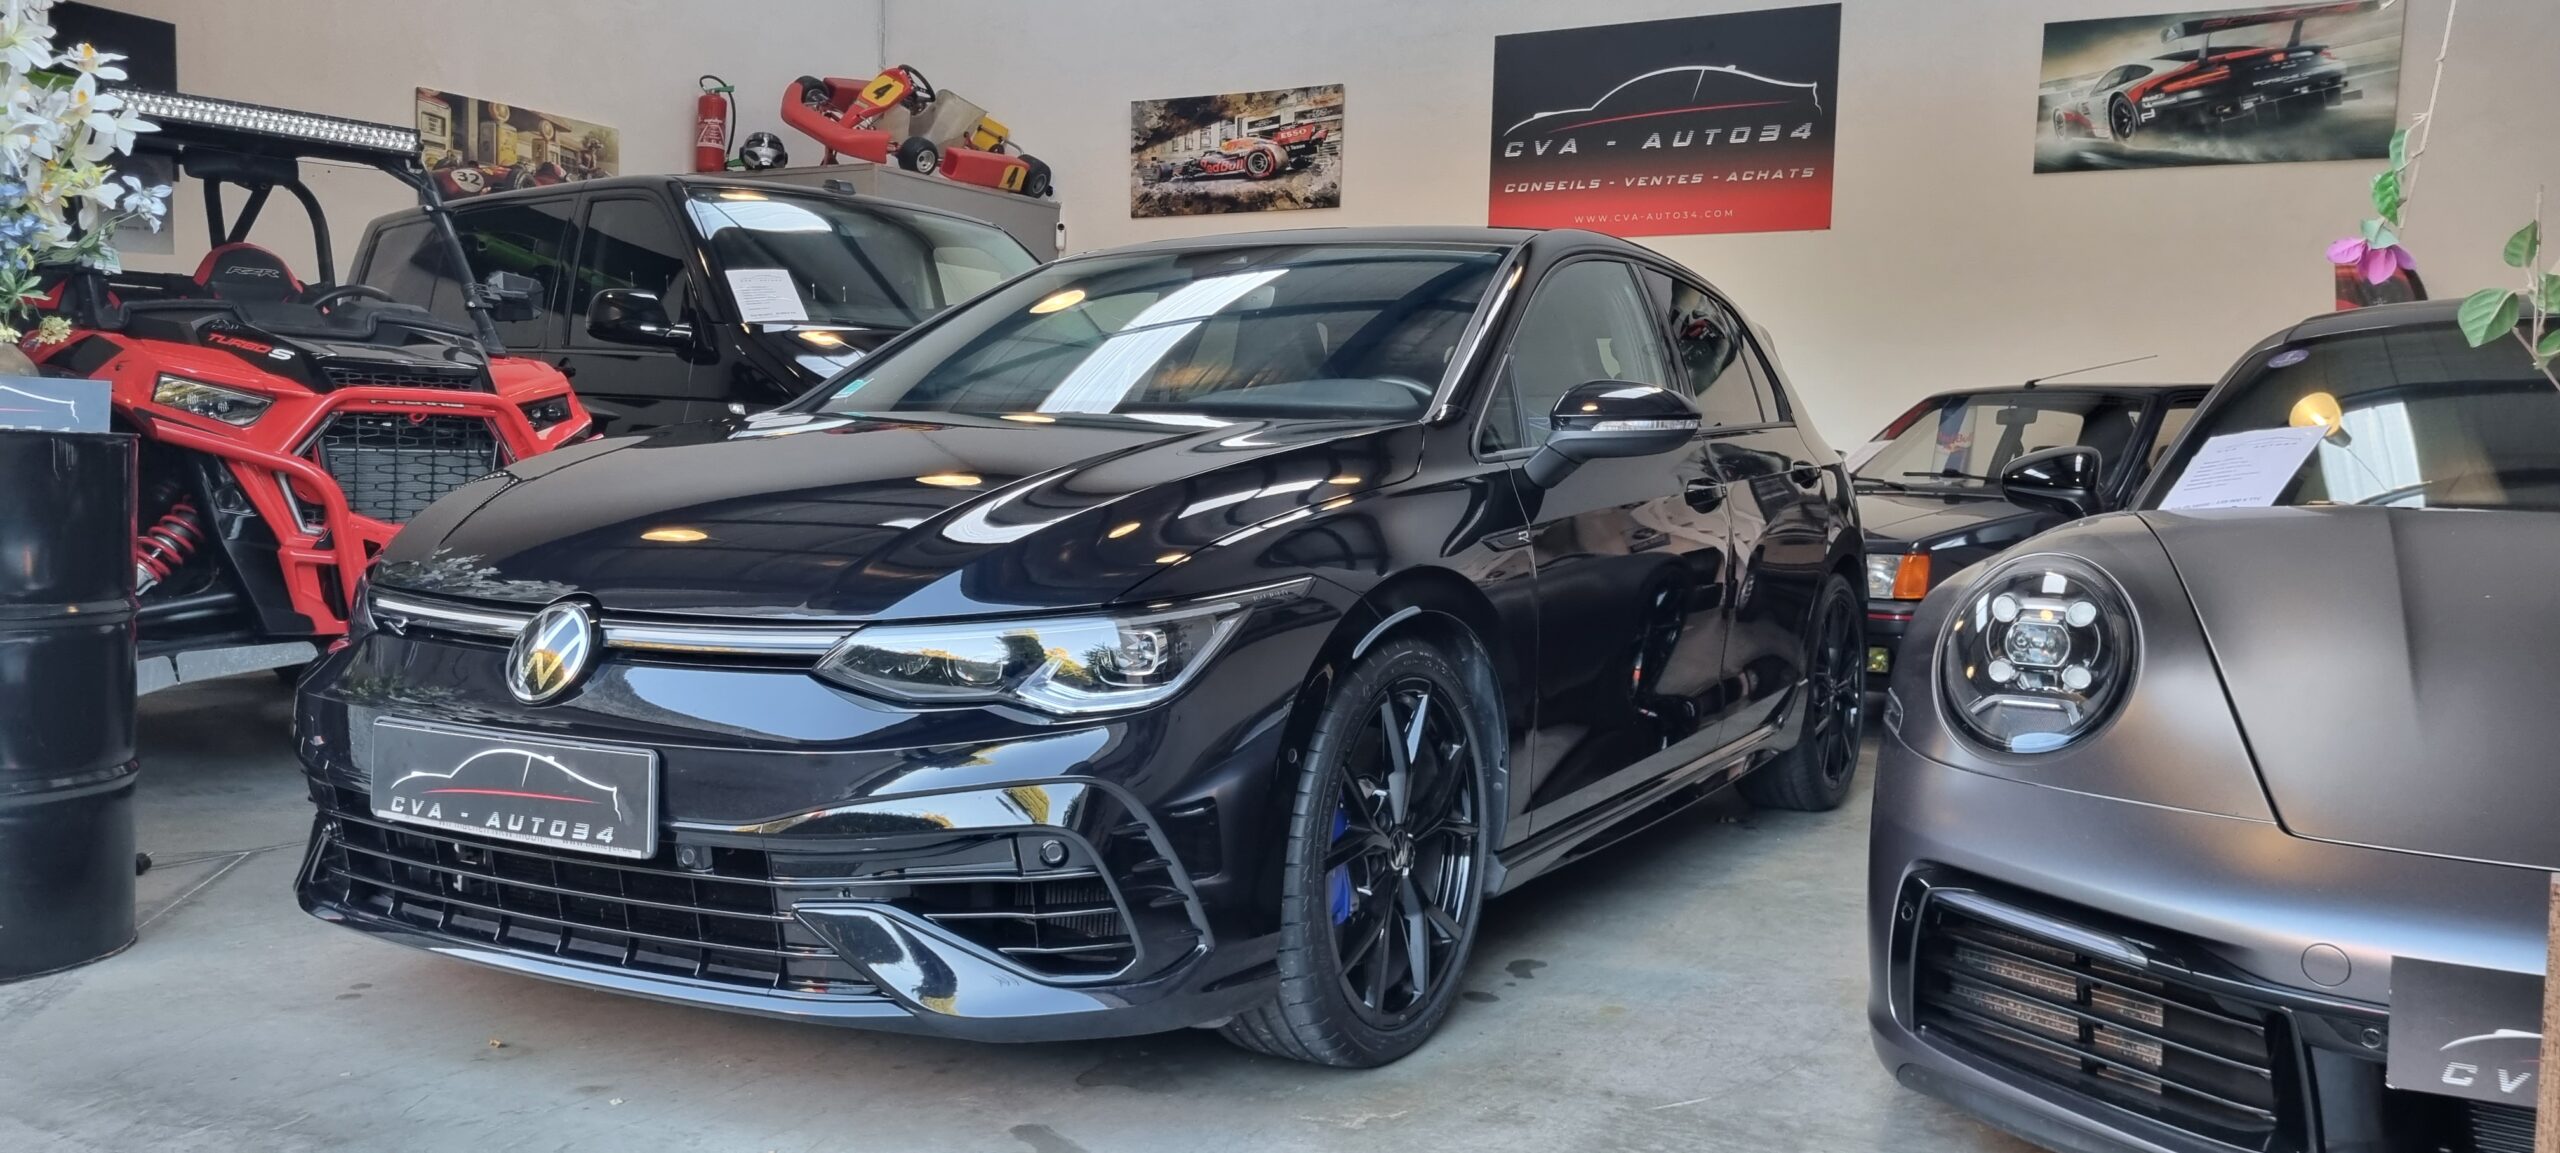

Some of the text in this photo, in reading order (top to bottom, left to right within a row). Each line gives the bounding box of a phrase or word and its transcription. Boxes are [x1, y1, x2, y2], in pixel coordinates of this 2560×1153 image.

[873, 83, 894, 100] 4
[1280, 128, 1306, 138] ESSO
[1504, 138, 1578, 158] CVA
[1641, 122, 1813, 150] AUTO34
[456, 171, 481, 186] 32
[1006, 167, 1019, 188] 4
[1504, 179, 1601, 193] CONSEILS
[1624, 173, 1704, 187] VENTES
[1726, 167, 1815, 182] ACHATS
[1574, 209, 1734, 223] WWW.CVA-AUTO34.COM
[208, 333, 295, 360] TURBO S
[390, 796, 443, 819] CVA
[485, 811, 615, 843] AUTO34
